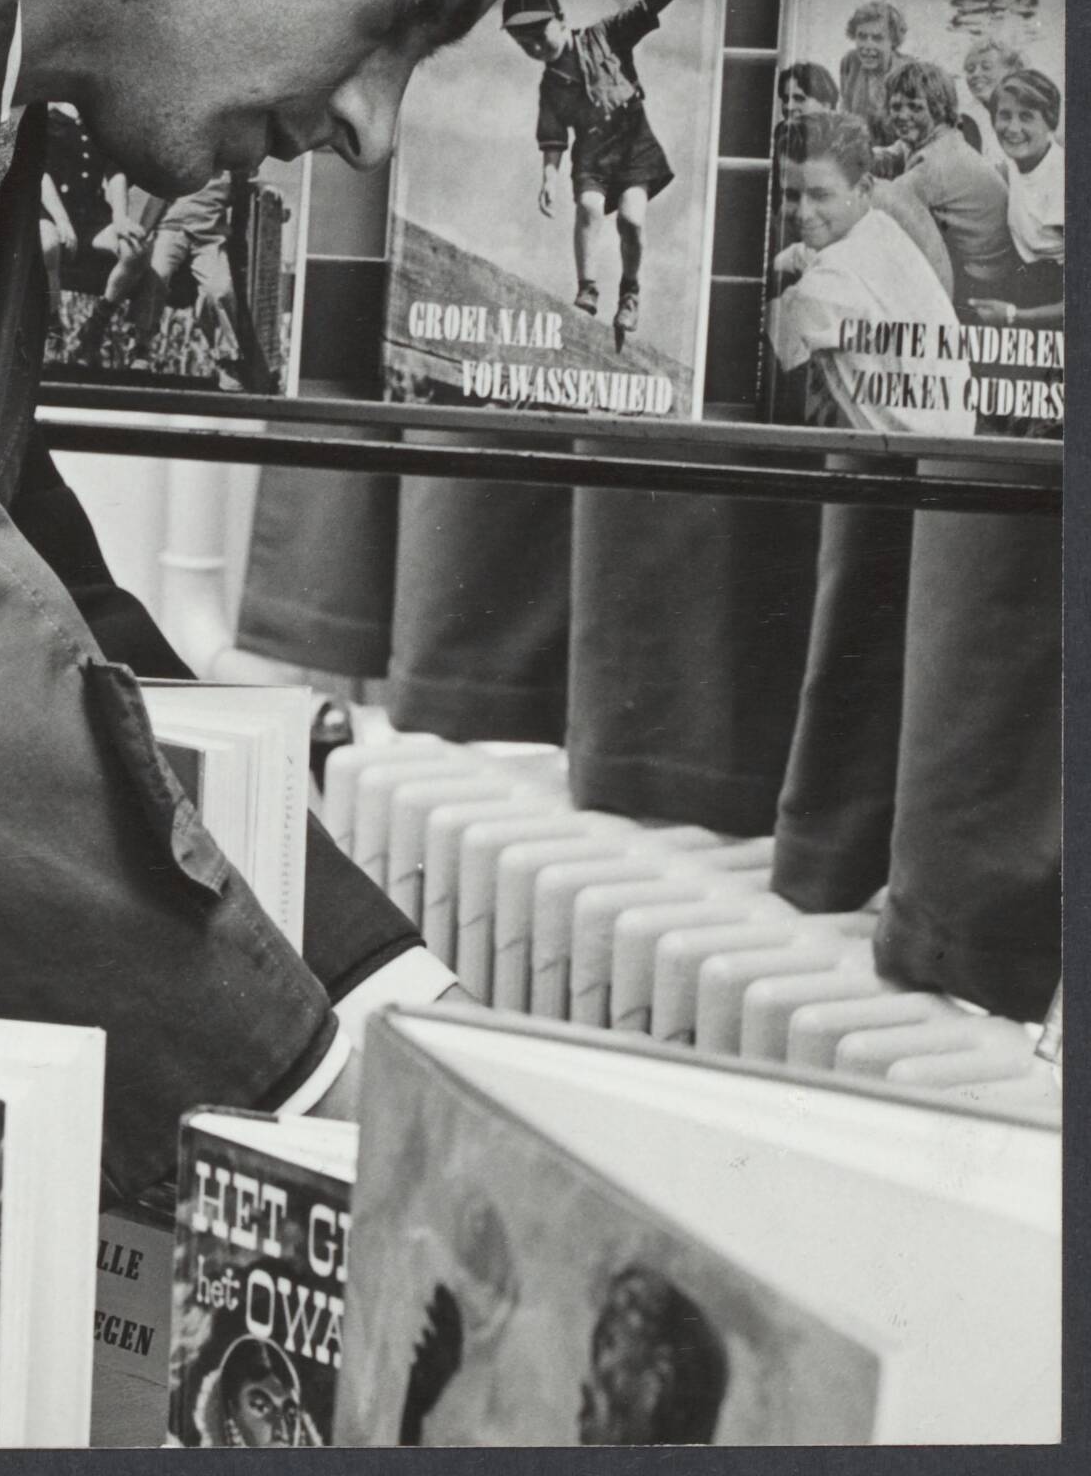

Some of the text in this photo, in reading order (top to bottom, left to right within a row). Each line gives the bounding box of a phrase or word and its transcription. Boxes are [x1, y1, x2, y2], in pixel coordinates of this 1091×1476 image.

[409, 301, 564, 350] GROEI NAAR
[839, 318, 926, 359] GROTE
[461, 359, 674, 415] VOLWASSENHEID
[850, 368, 1064, 420] ZOEKEN OUDERS
[191, 1159, 289, 1259] HET
[196, 1254, 241, 1312] het
